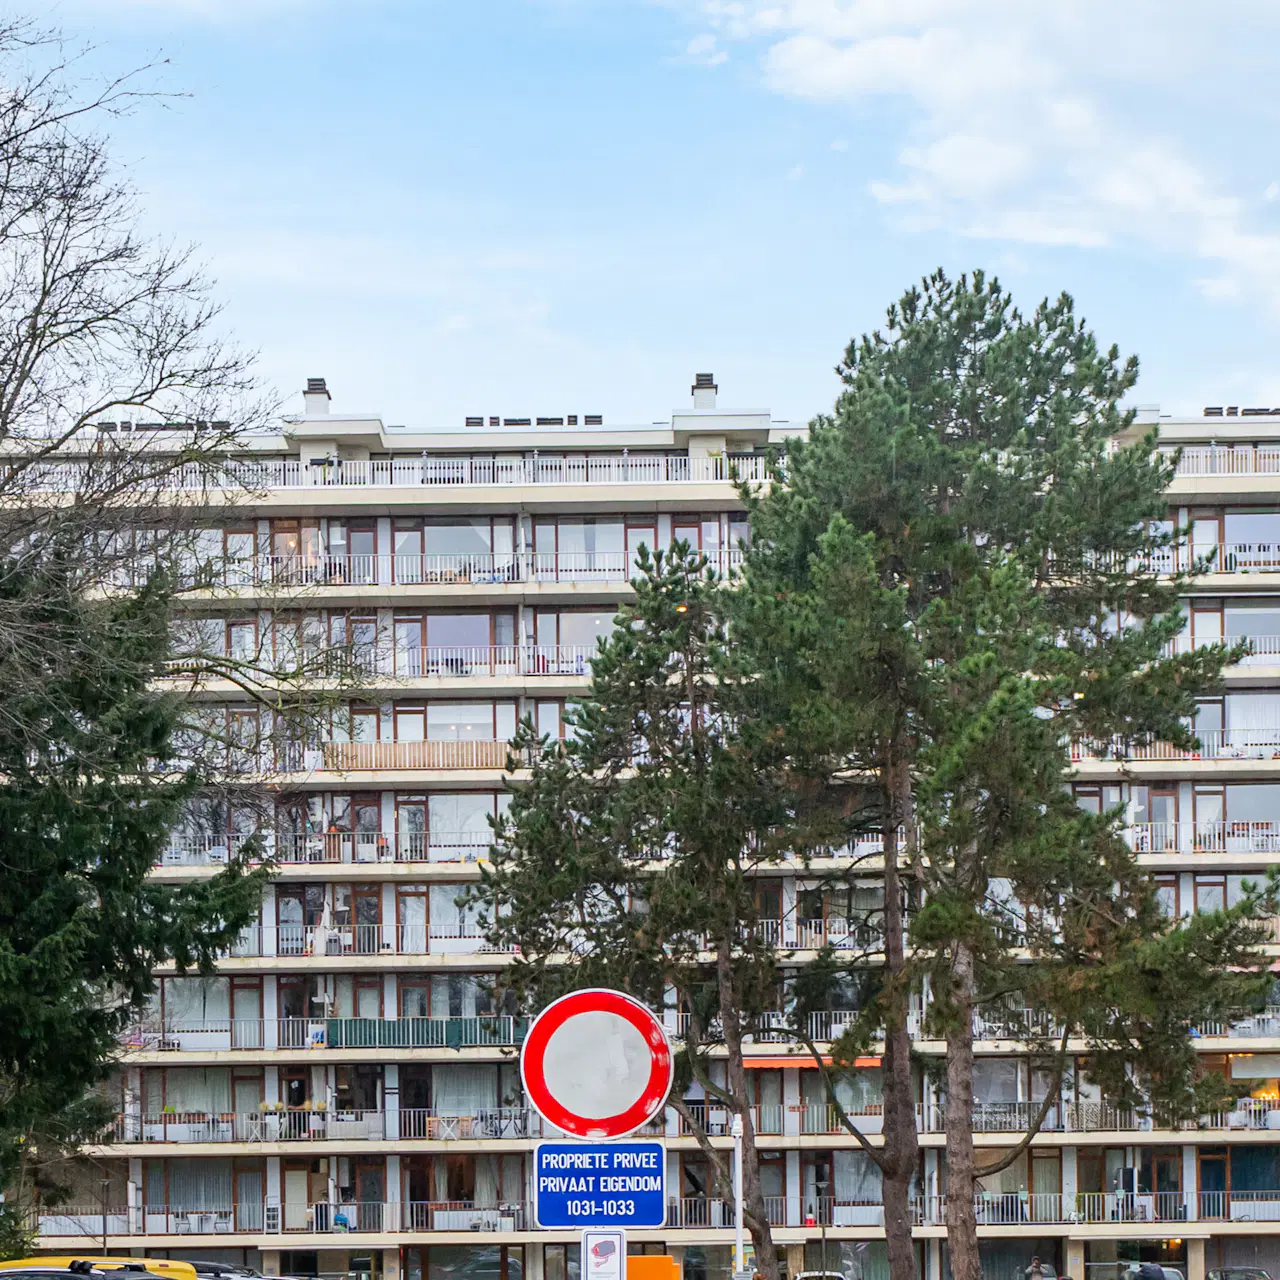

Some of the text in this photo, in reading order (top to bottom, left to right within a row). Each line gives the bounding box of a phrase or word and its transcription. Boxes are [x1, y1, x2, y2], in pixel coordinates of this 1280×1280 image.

[541, 1152, 658, 1169] PROPRIETE PRIVEE
[539, 1176, 661, 1192] PRIVAAT EIGENDOM
[566, 1200, 635, 1216] 1031-1033
